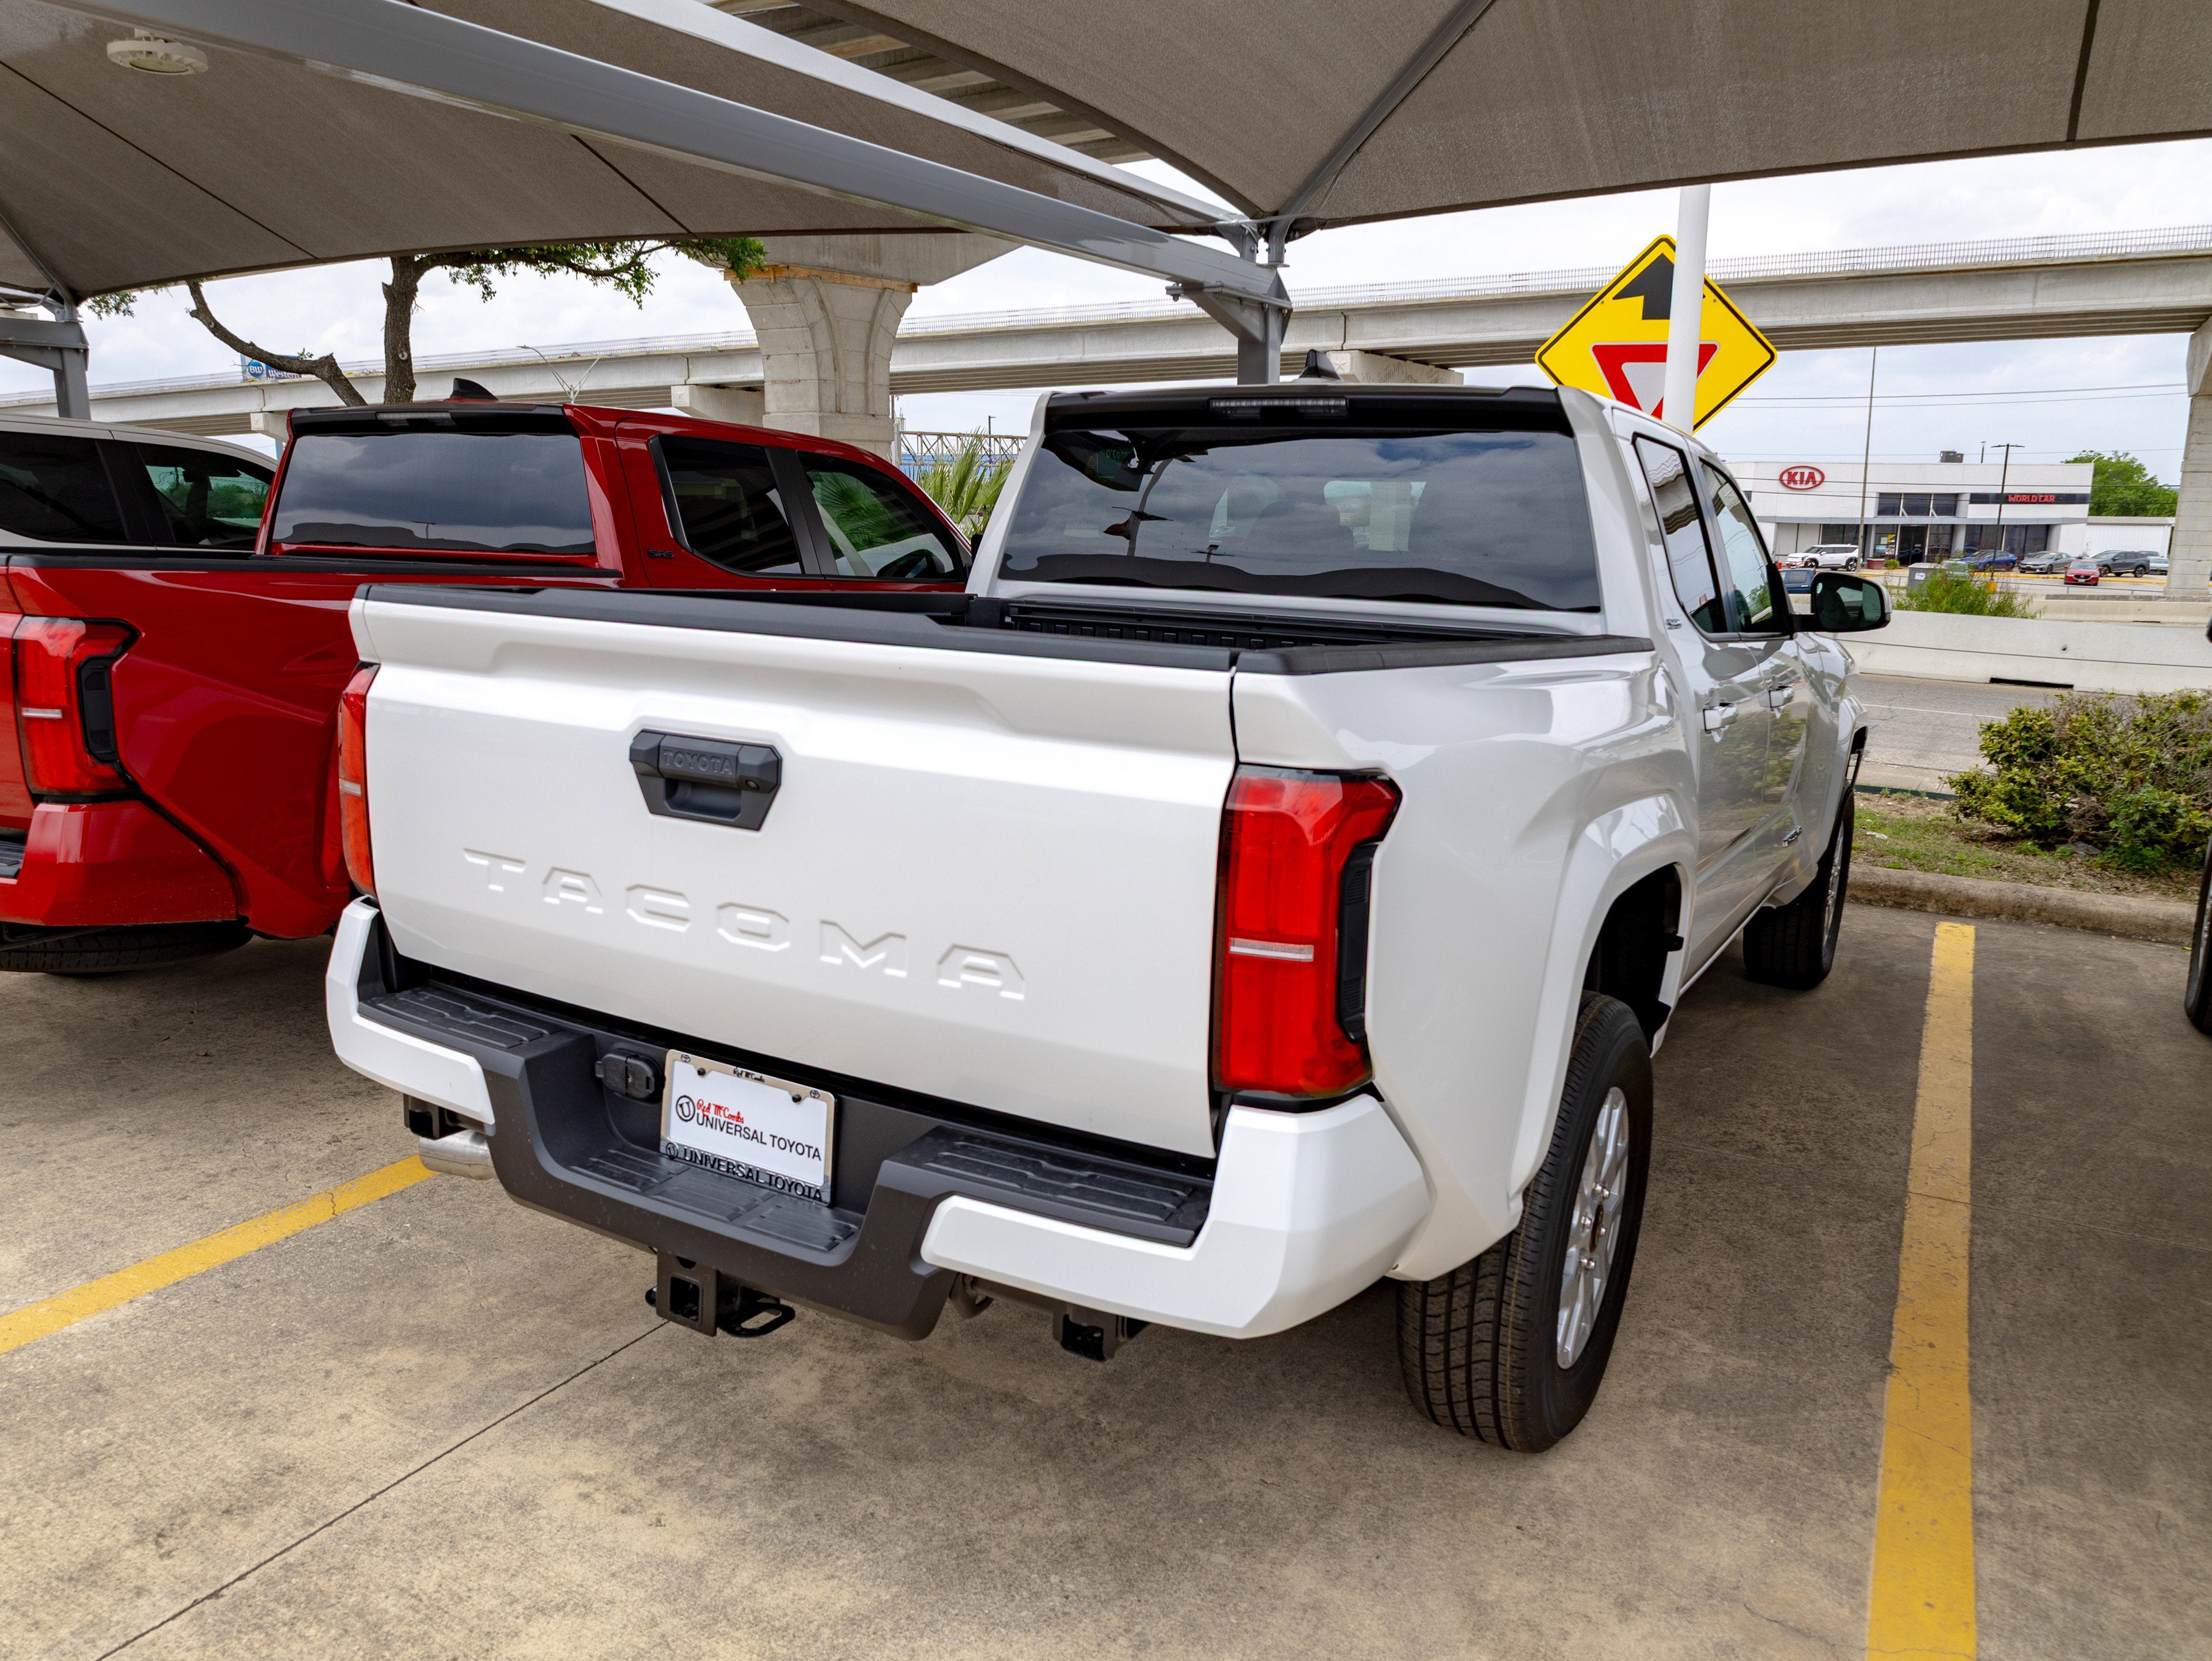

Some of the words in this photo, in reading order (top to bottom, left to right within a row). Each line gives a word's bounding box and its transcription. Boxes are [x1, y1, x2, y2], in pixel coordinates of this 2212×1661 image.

[249, 366, 263, 374] BW
[268, 369, 299, 379] Western
[1106, 449, 1130, 459] O'Conn
[1787, 471, 1817, 485] KIA
[664, 749, 733, 775] TOYOTA
[463, 848, 1025, 1000] TACOMA
[697, 1099, 711, 1117] Red
[713, 1103, 744, 1123] McCombs
[696, 1113, 767, 1145] UNIVERSAL
[770, 1134, 821, 1161] TOYOTA
[683, 1146, 765, 1183] UNIVERSAL
[766, 1171, 823, 1201] TOYOTA
